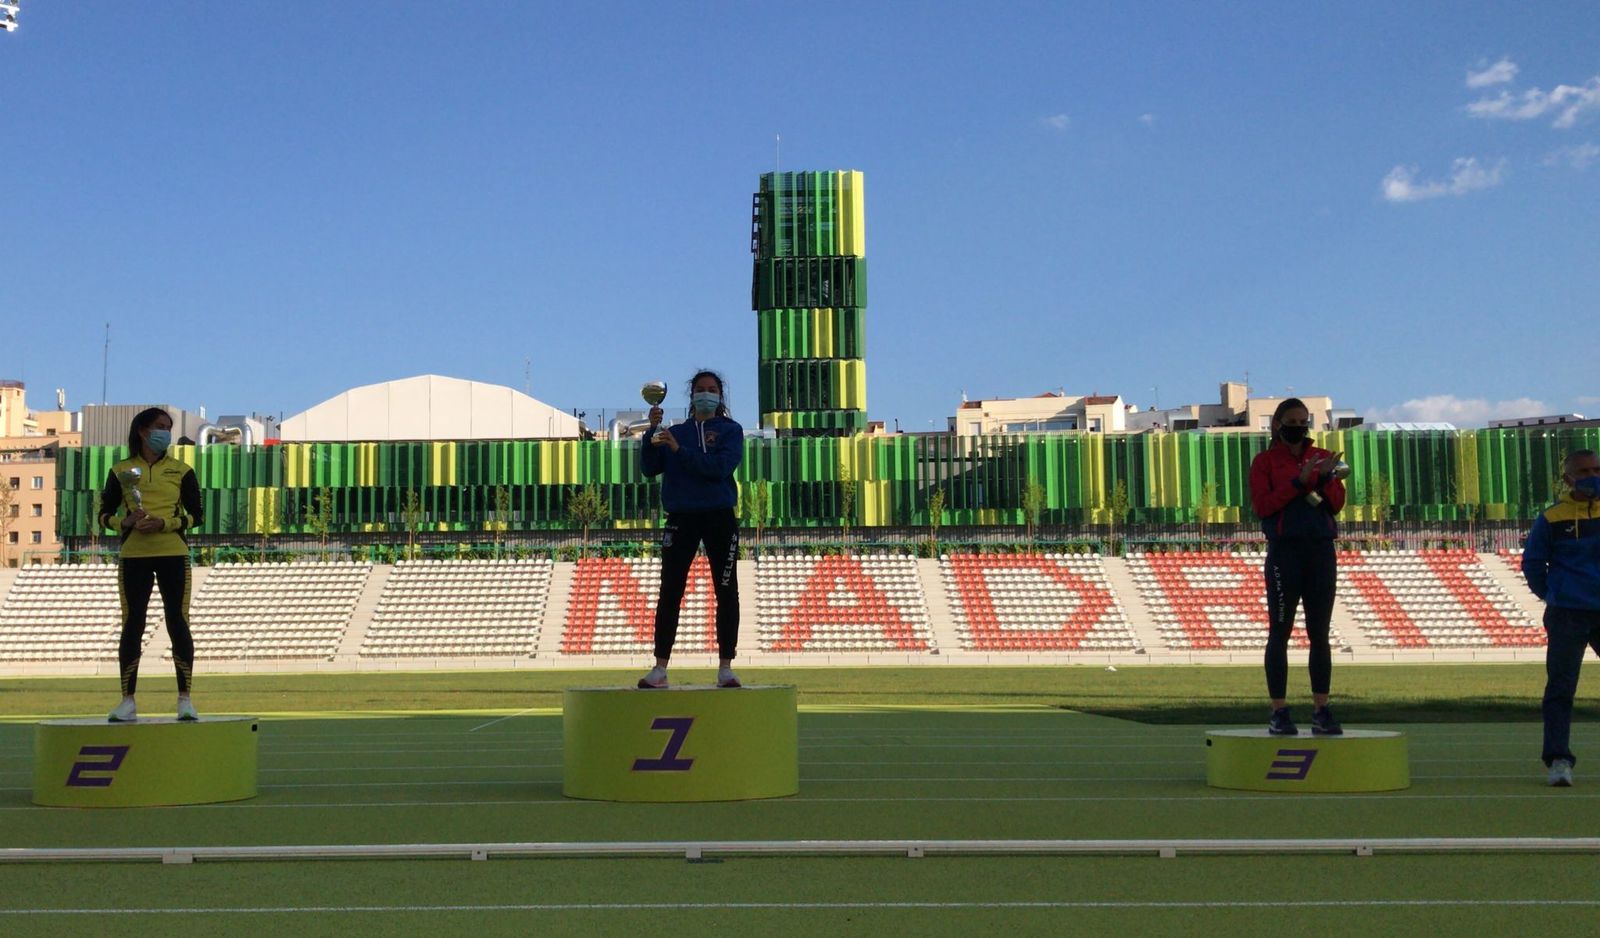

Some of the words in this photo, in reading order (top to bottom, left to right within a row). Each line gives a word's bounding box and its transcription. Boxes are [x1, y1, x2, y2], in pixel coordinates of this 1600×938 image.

[721, 543, 737, 586] KELME
[631, 717, 695, 771] 1
[1266, 749, 1318, 780] 3
[65, 746, 130, 786] 2
